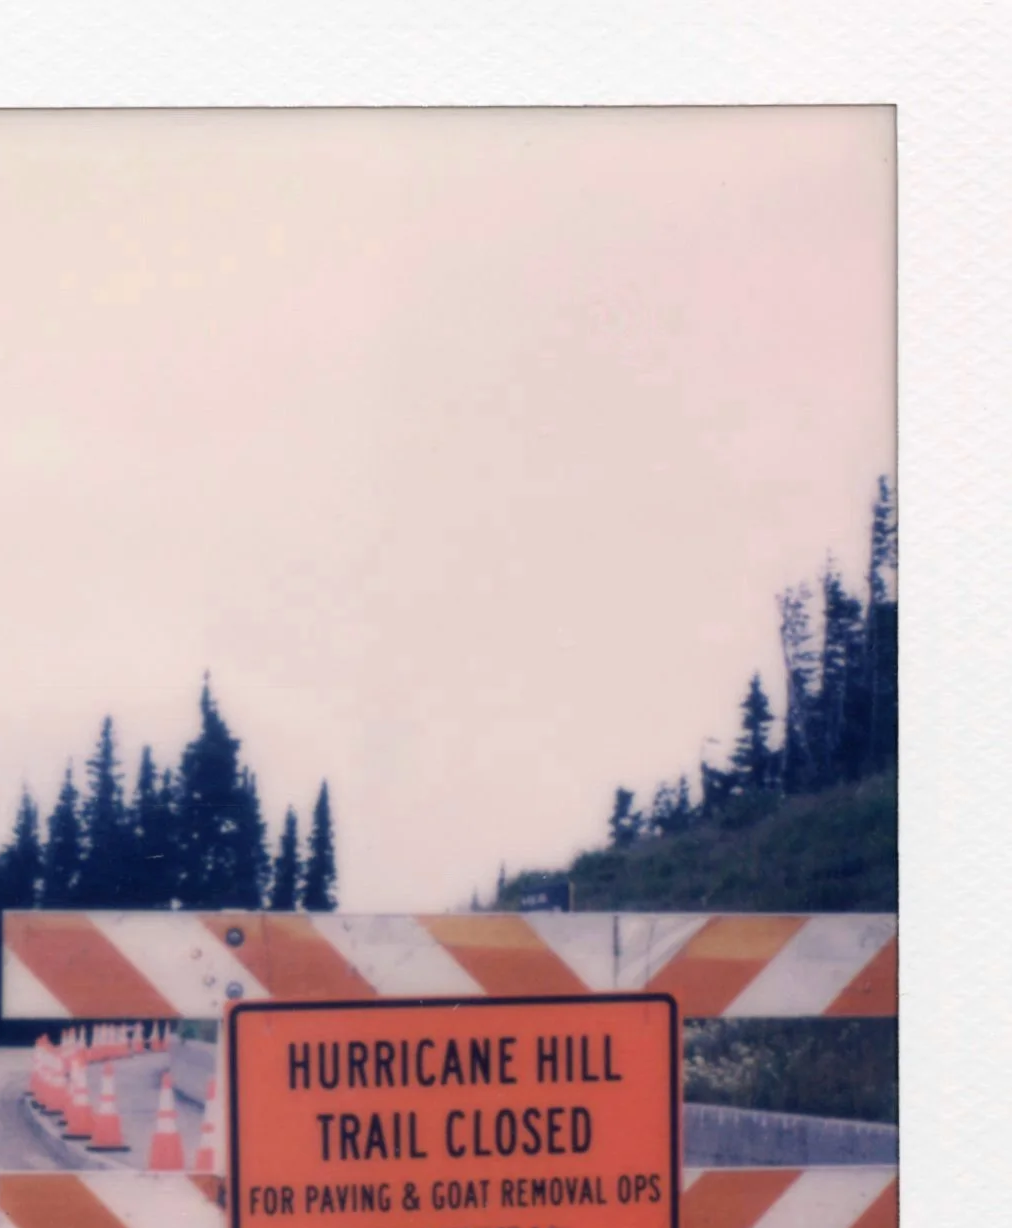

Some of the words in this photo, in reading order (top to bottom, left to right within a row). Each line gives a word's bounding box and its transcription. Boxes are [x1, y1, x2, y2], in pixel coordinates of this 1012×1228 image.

[287, 1036, 518, 1090] HURRICANE
[535, 1035, 623, 1083] HILL
[316, 1111, 428, 1161] TRAIL
[445, 1106, 592, 1159] CLOSED
[249, 1186, 294, 1216] FOR
[305, 1183, 391, 1213] PAVING
[401, 1182, 421, 1211] &
[431, 1180, 490, 1211] GOAT
[501, 1177, 607, 1208] REMOVAL
[617, 1173, 661, 1204] OPS
